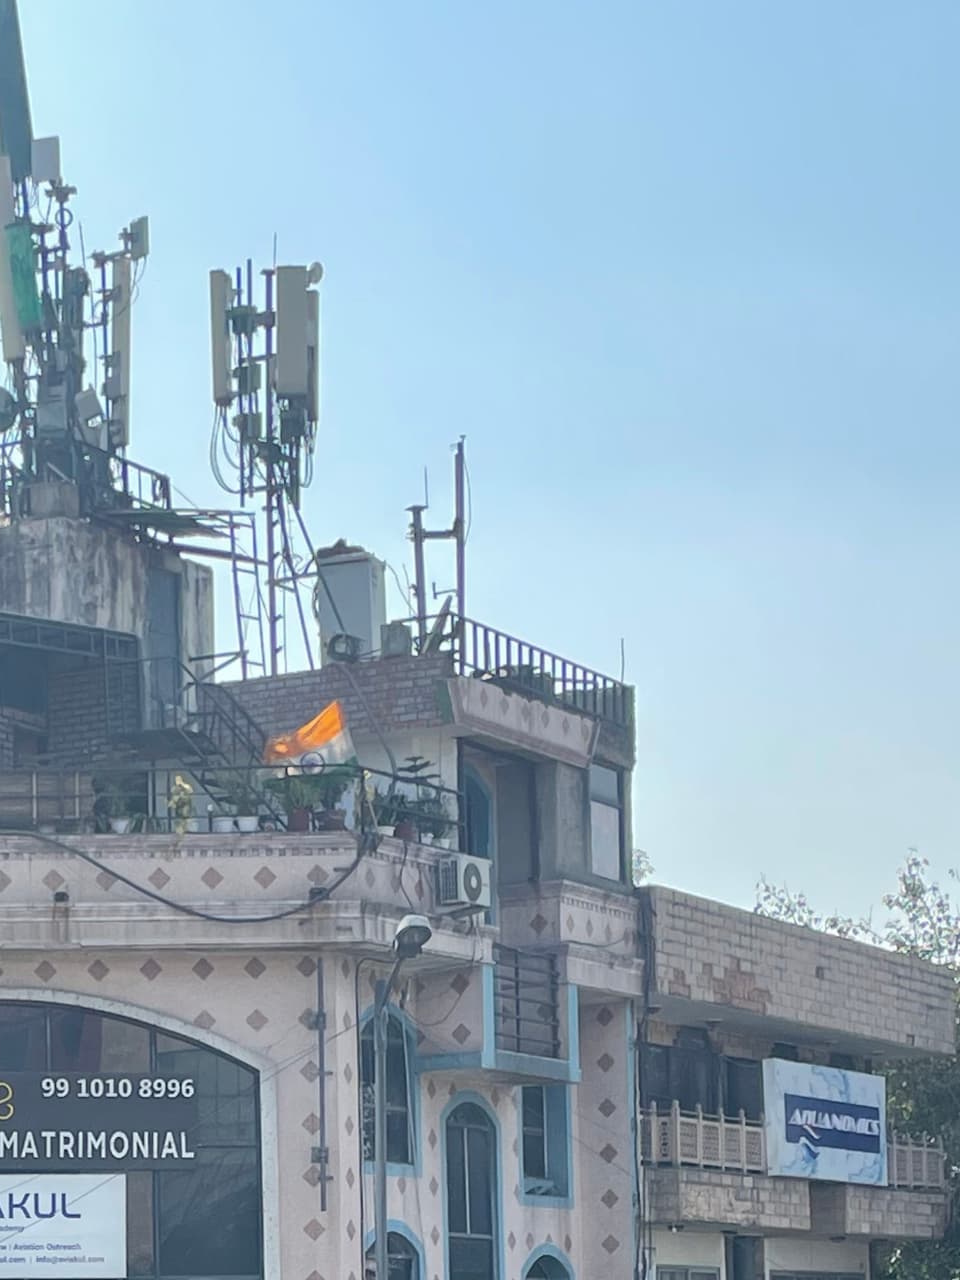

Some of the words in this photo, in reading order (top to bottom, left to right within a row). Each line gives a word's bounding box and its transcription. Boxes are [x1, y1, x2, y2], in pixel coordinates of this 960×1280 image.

[41, 1079, 69, 1098] 99
[77, 1079, 132, 1098] 1010
[139, 1078, 194, 1098] 8996
